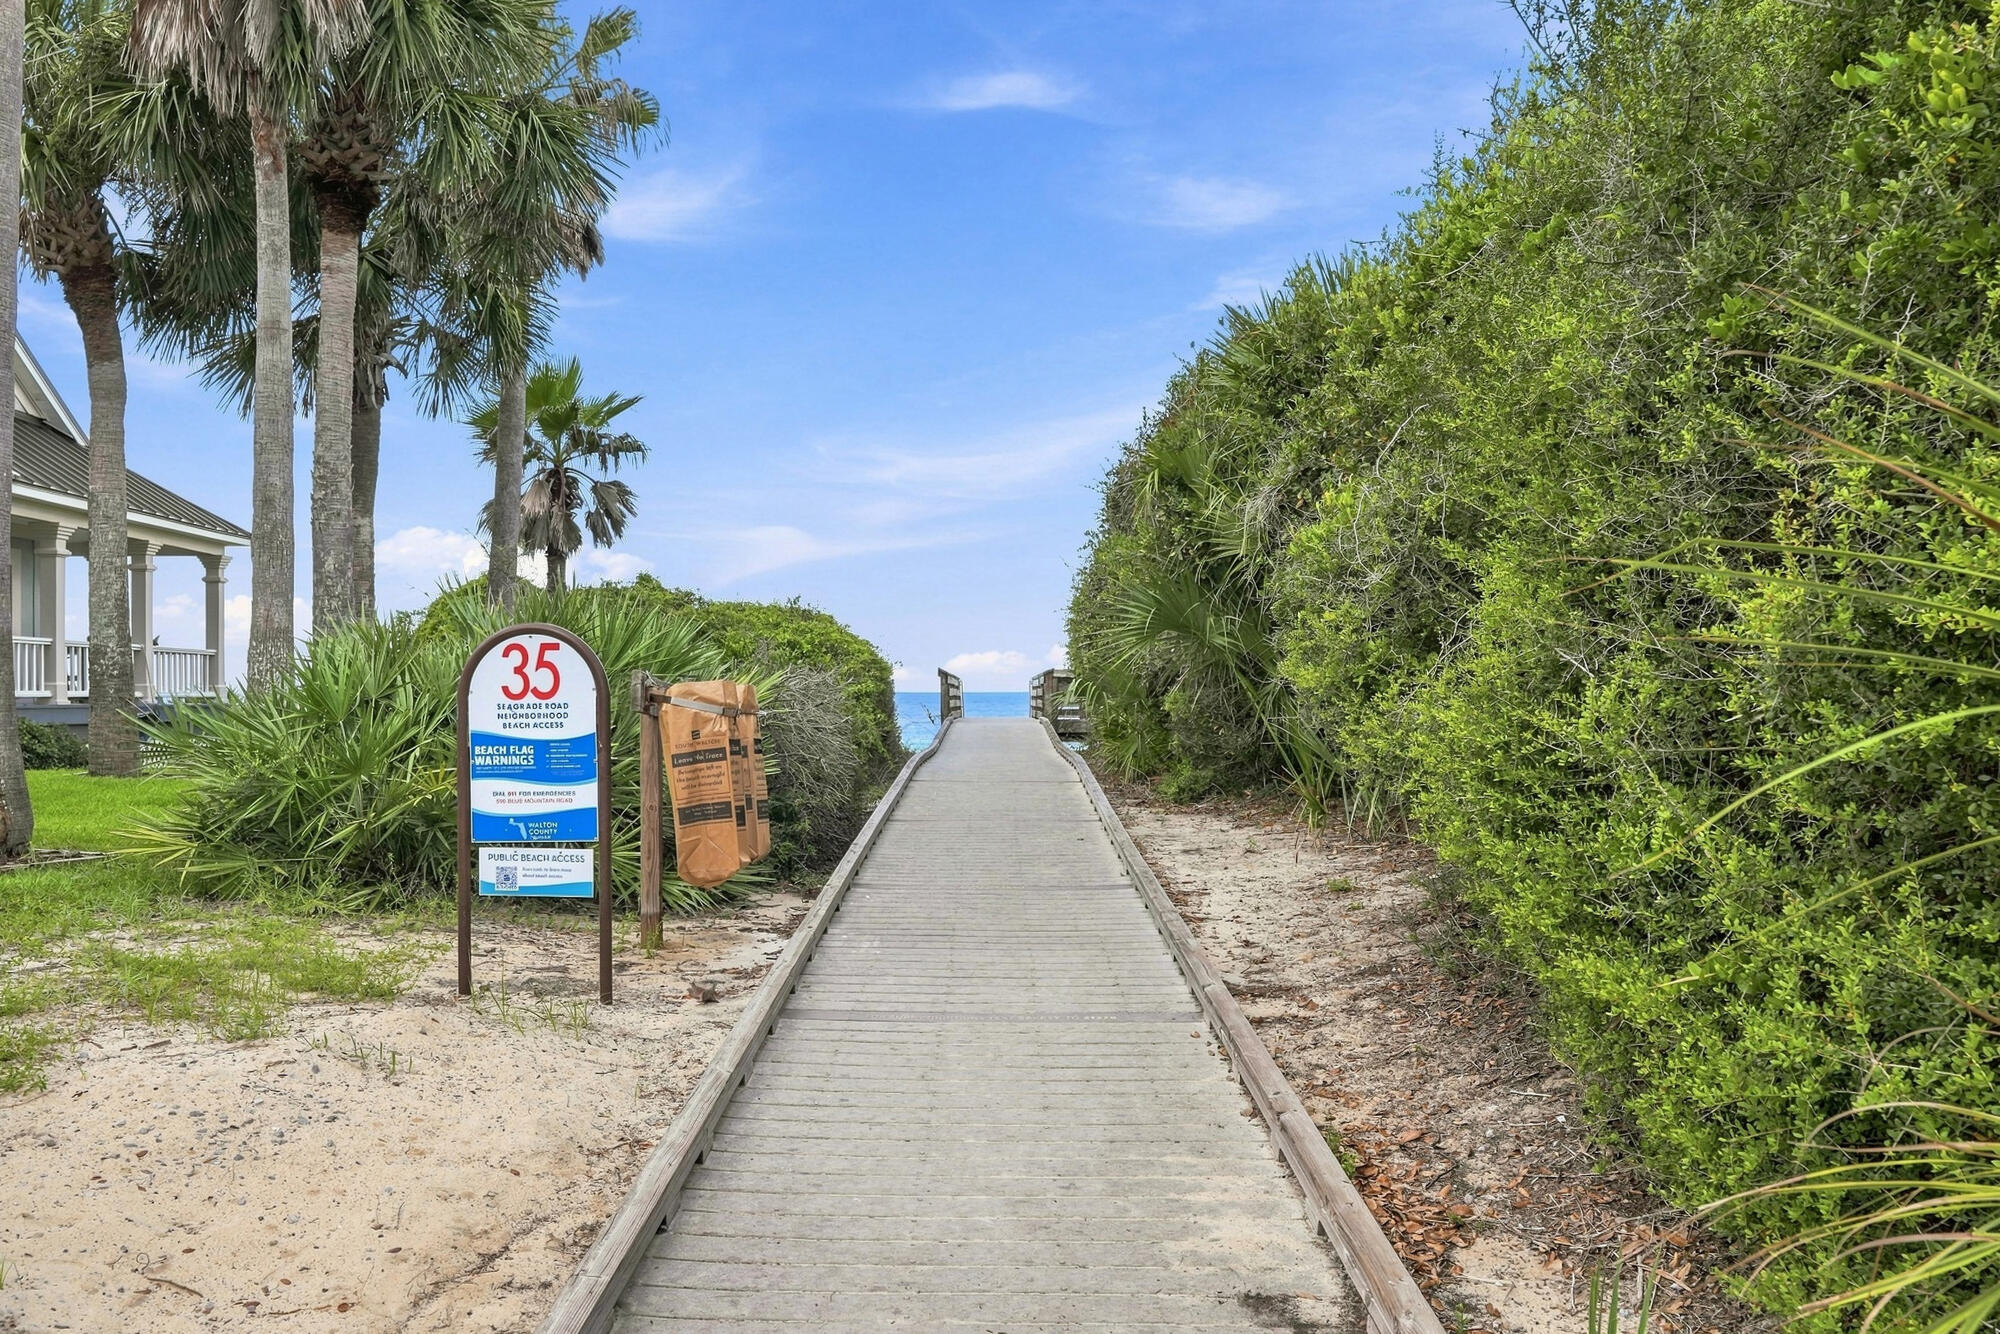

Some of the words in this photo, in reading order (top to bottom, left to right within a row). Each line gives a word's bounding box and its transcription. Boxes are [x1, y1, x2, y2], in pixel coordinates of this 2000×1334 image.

[501, 642, 561, 701] 35
[545, 702, 569, 710] ROAD
[497, 712, 569, 720] NEIGHBORHOOD
[474, 746, 507, 754] BEACH
[509, 745, 534, 754] FLAG
[474, 755, 534, 766] WARNINGS
[488, 853, 519, 862] PUBLIC
[520, 853, 550, 862] BEACH
[551, 854, 585, 863] ACCESS
